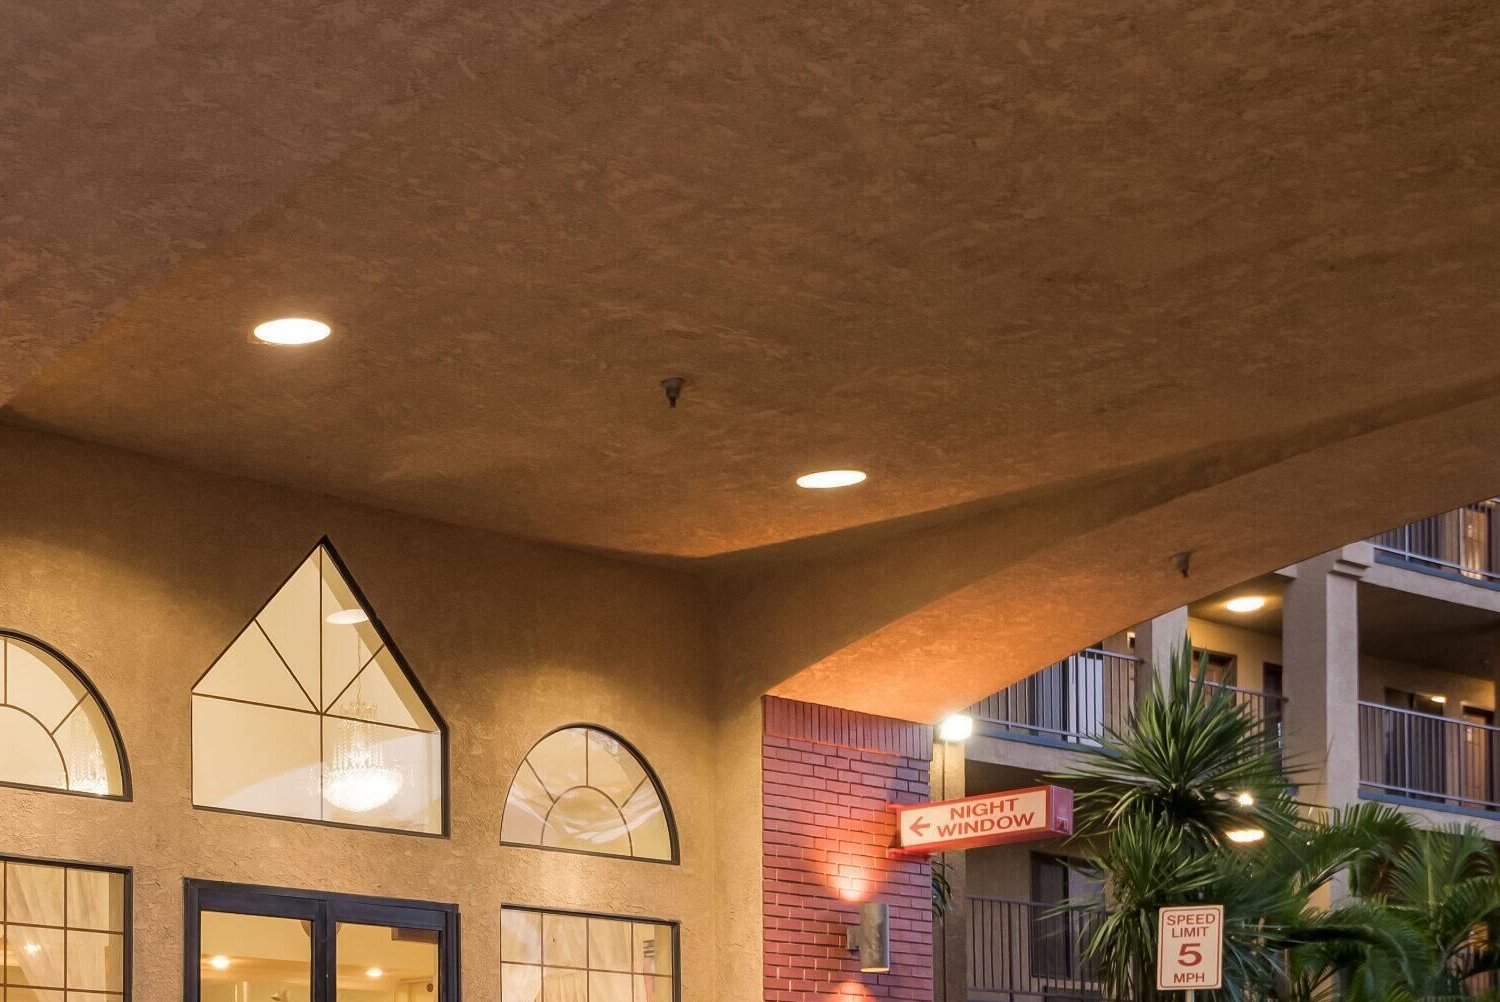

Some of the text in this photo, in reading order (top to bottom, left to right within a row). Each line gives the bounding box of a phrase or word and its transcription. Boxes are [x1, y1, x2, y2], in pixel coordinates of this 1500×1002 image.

[950, 797, 1020, 820] NIGHT
[936, 811, 1036, 838] WINDOW
[1166, 913, 1216, 926] SPEED
[1171, 926, 1209, 938] LIMIT
[1177, 942, 1203, 967] 5
[1173, 972, 1205, 983] MPH
